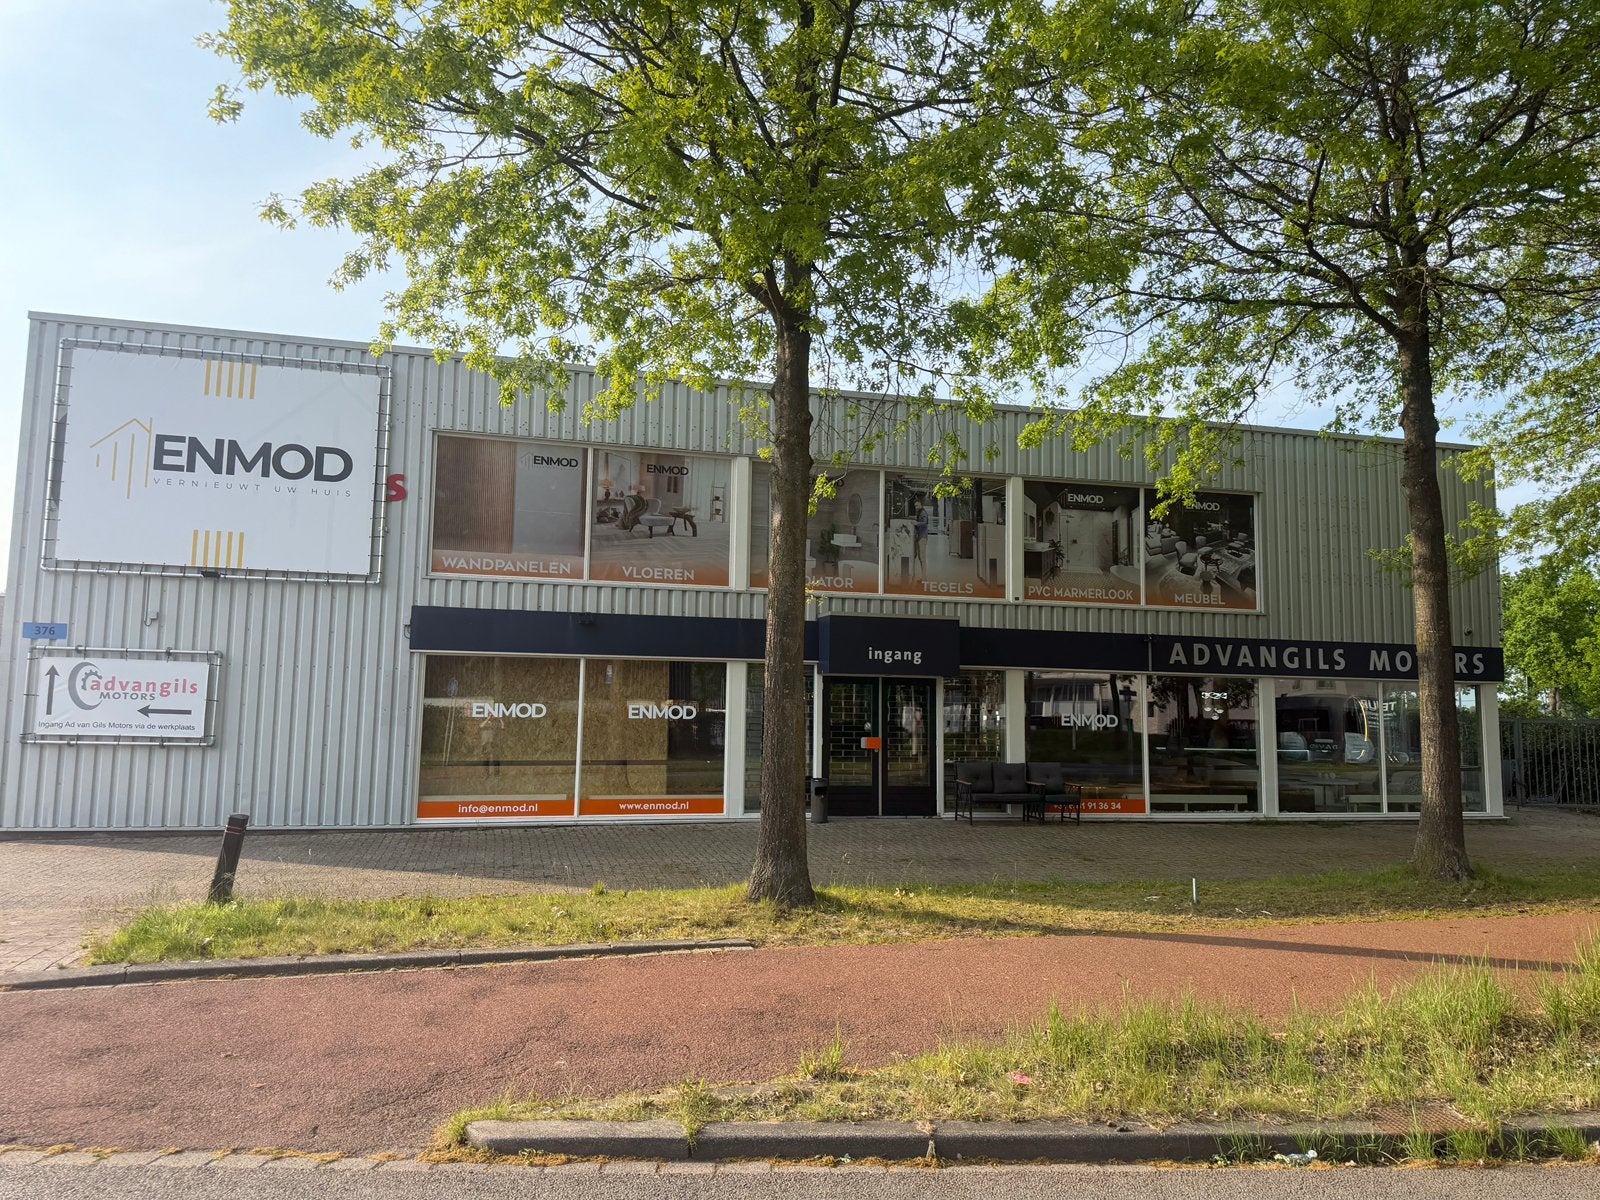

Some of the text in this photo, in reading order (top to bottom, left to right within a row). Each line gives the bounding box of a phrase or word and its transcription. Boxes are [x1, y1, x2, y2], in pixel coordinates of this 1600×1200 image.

[153, 434, 353, 482] ENMOD
[533, 455, 578, 468] ENMOD
[647, 464, 689, 475] ENMOD
[153, 477, 351, 497] VERNIEUWT UW HUIS
[1067, 493, 1104, 504] ENMOD
[441, 556, 571, 575] WANDPANELEN
[622, 566, 695, 581] VLOEREN
[921, 581, 974, 594] TEGELS
[1028, 585, 1134, 600] PVC MARMERLOOK
[1174, 593, 1226, 605] MEUBEL
[34, 625, 56, 636] 376
[868, 646, 922, 664] ingang
[1169, 642, 1485, 675] ADVANGILS MORS
[90, 675, 198, 697] advangils
[99, 691, 156, 701] MOTORS
[471, 703, 547, 719] ENMOD
[627, 705, 697, 720] ENMOD
[38, 720, 63, 729] Ingang
[64, 720, 75, 728] Ad
[92, 721, 106, 729] Gils
[134, 722, 146, 730] via
[146, 722, 156, 730] de
[157, 723, 196, 732] werkplaats
[1061, 713, 1119, 728] ENMOD
[458, 803, 539, 815] info@enmod.nl
[618, 801, 689, 811] www.enmod.nl
[1087, 802, 1097, 810] 91
[1098, 802, 1109, 810] 36
[1110, 802, 1121, 810] 34
